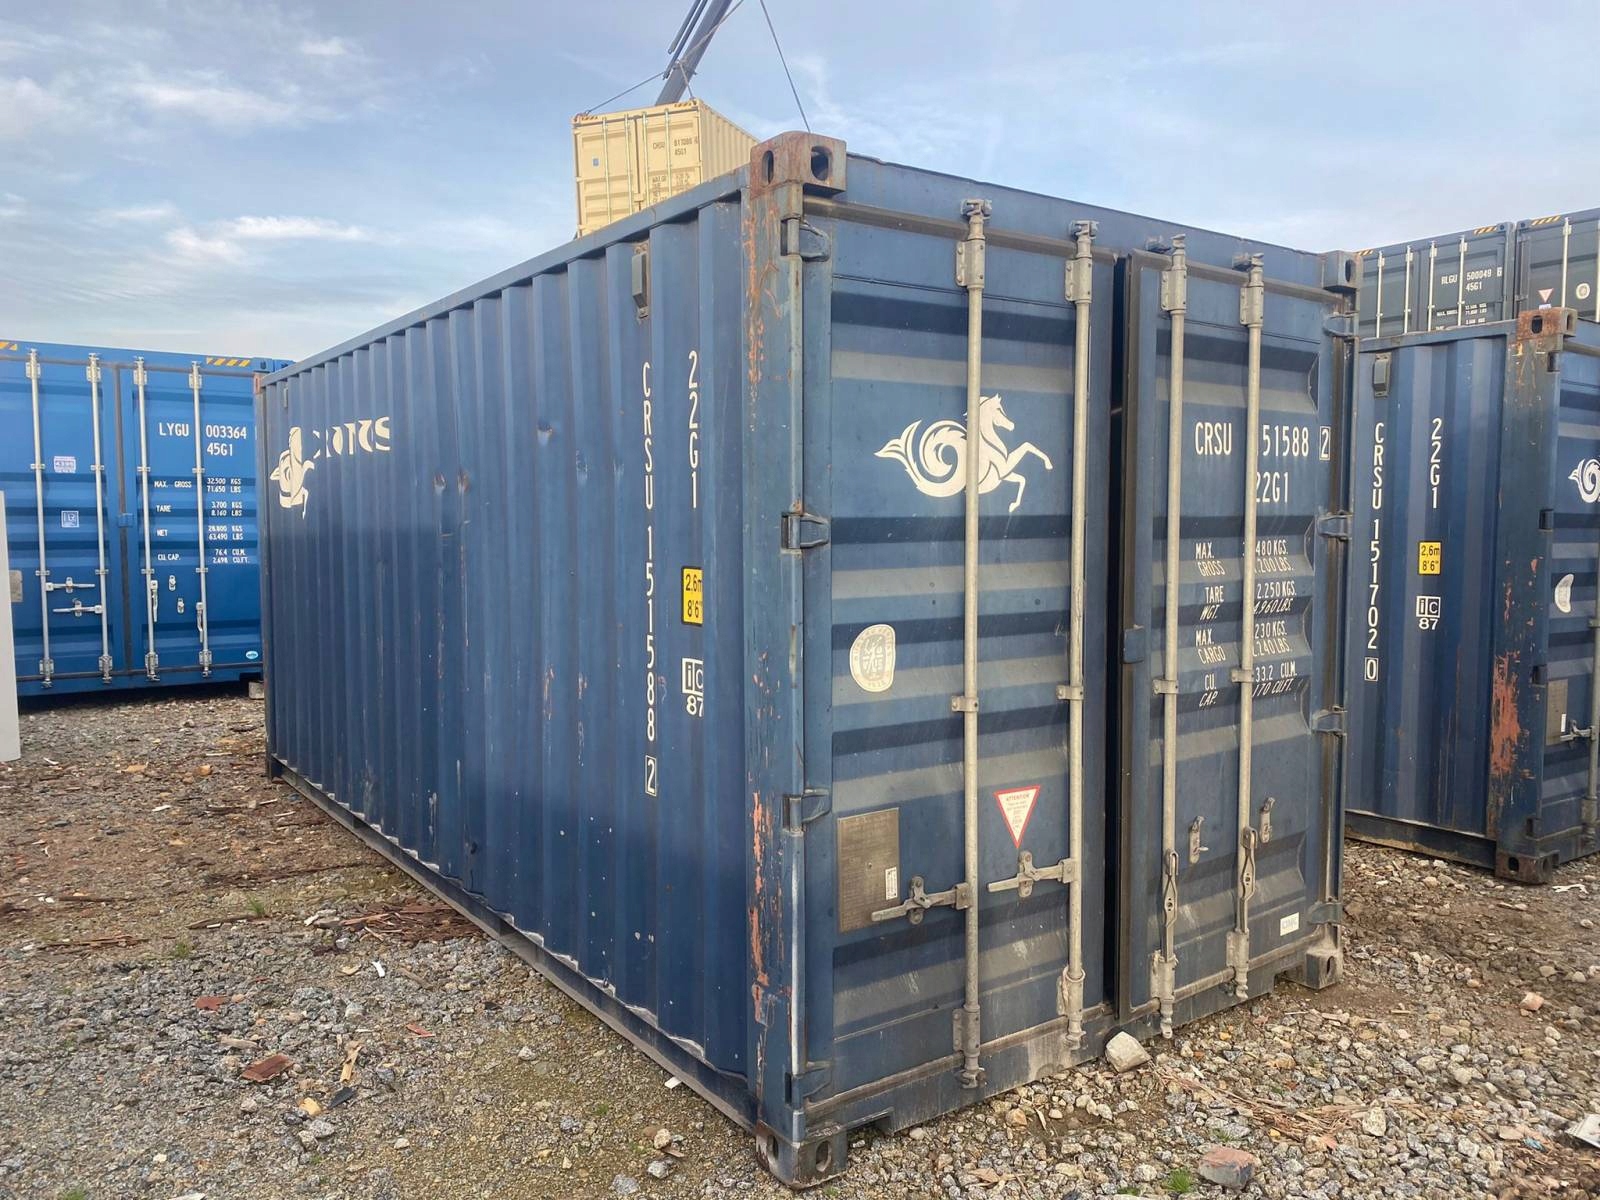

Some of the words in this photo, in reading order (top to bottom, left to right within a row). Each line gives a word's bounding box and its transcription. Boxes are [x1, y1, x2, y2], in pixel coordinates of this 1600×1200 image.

[1465, 281, 1482, 292] 45G1
[159, 422, 190, 437] LYGU
[205, 425, 247, 440] 003364
[642, 361, 653, 510] CRSU
[688, 350, 699, 509] 22G1
[1194, 421, 1232, 456] CRSU
[1257, 424, 1309, 457] 51588
[1320, 426, 1331, 460] 2
[206, 442, 233, 457] 45G1
[1372, 422, 1384, 510] CRSU
[1430, 417, 1442, 509] 22G1
[174, 481, 192, 489] GROSS
[156, 505, 171, 513] TARE
[156, 529, 169, 537] NET
[1195, 542, 1215, 560] MAX.
[1273, 539, 1289, 555] KGS.
[1197, 560, 1226, 577] GROSS
[1276, 557, 1294, 573] LBS.
[1204, 585, 1225, 604] TARE
[1256, 583, 1280, 600] 2.250
[1281, 581, 1297, 596] KGS.
[1367, 518, 1380, 650] 151702
[645, 525, 655, 742] 151588
[1195, 628, 1215, 647] MAX.
[1272, 620, 1288, 636] KGS.
[1418, 618, 1439, 631] 87
[1197, 645, 1227, 665] CARGO
[1204, 673, 1217, 691] CU.
[1255, 664, 1274, 683] 33.2
[1364, 656, 1379, 682] 0
[1199, 691, 1219, 708] CAP.
[645, 755, 657, 797] 2
